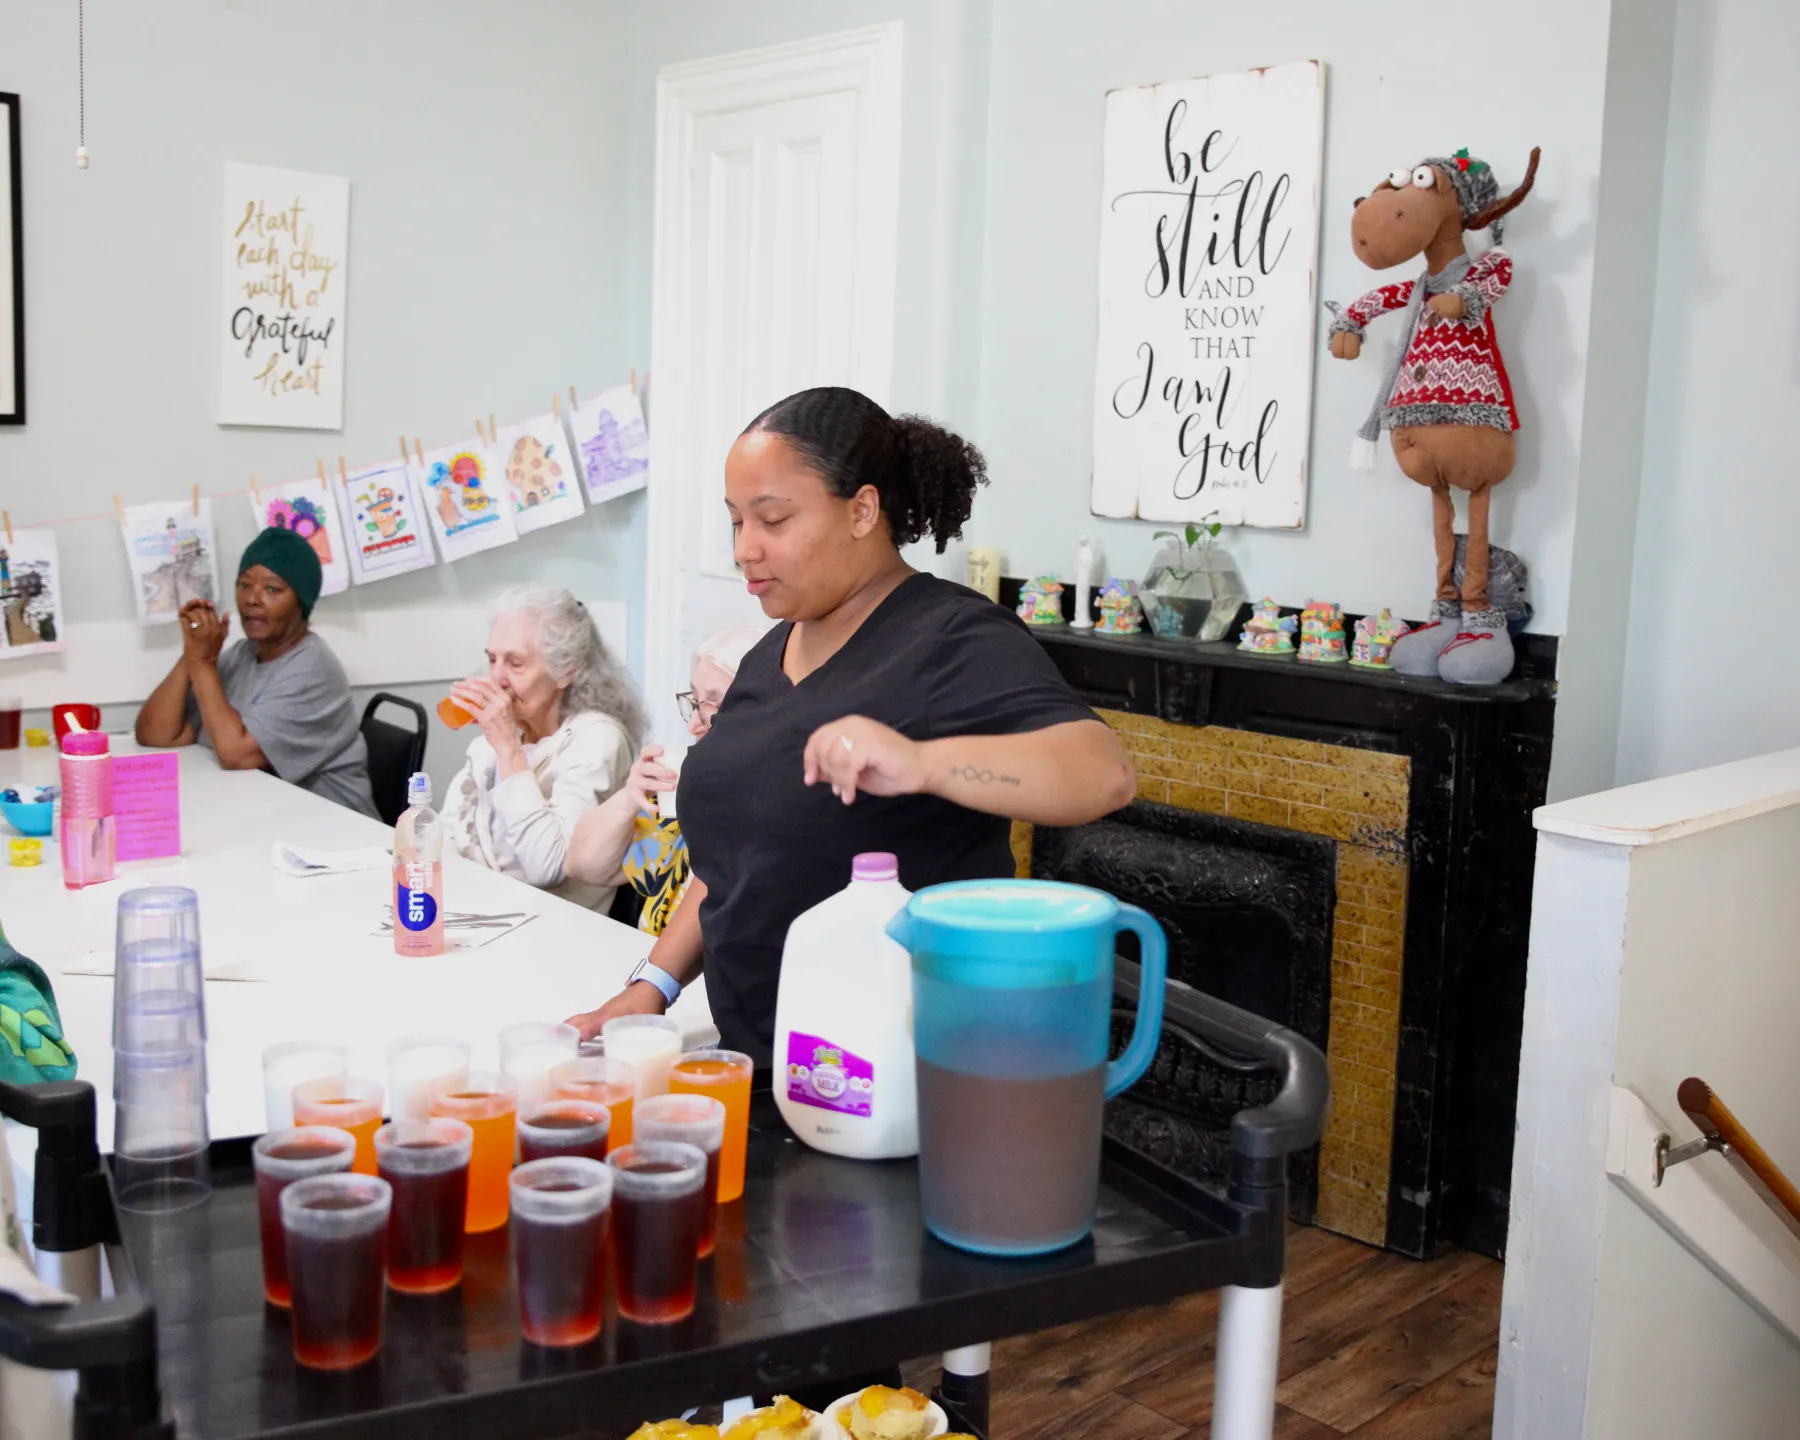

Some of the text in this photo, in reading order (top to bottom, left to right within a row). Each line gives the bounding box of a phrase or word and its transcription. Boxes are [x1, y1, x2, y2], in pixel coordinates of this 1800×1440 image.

[1164, 98, 1240, 185] be
[236, 222, 338, 292] each day
[1111, 170, 1292, 298] still
[241, 264, 320, 310] with a
[1198, 276, 1255, 300] AND
[231, 306, 336, 365] Grateful
[1184, 306, 1265, 330] KNOW
[1190, 336, 1256, 359] THAT
[252, 351, 325, 396] heart
[1112, 341, 1246, 430] I am
[1173, 399, 1279, 500] God
[405, 861, 425, 923] smart
